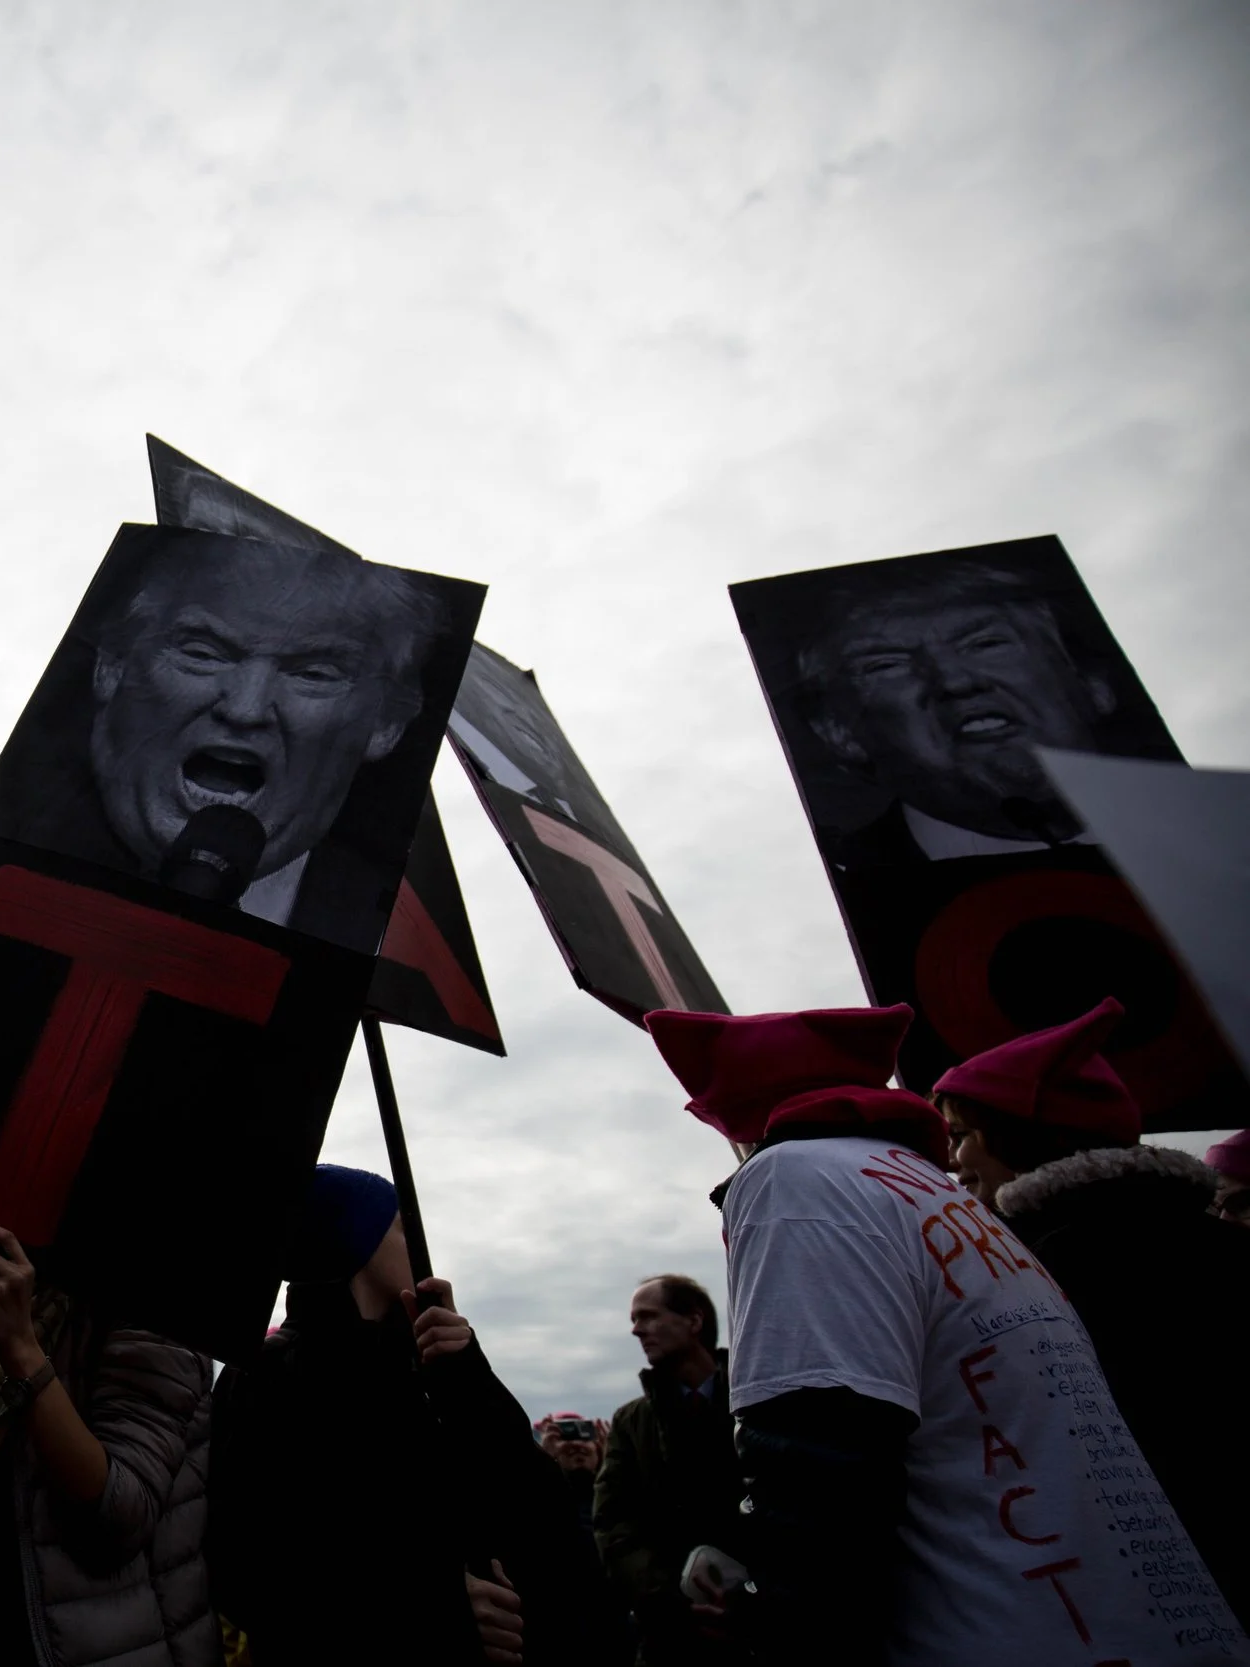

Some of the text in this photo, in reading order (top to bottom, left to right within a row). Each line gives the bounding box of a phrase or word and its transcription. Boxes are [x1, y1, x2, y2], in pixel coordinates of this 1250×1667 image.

[1090, 1462, 1136, 1486] having
[958, 1343, 1132, 1667] FACT
[1101, 1487, 1155, 1516] taking
[1157, 1600, 1218, 1628] having
